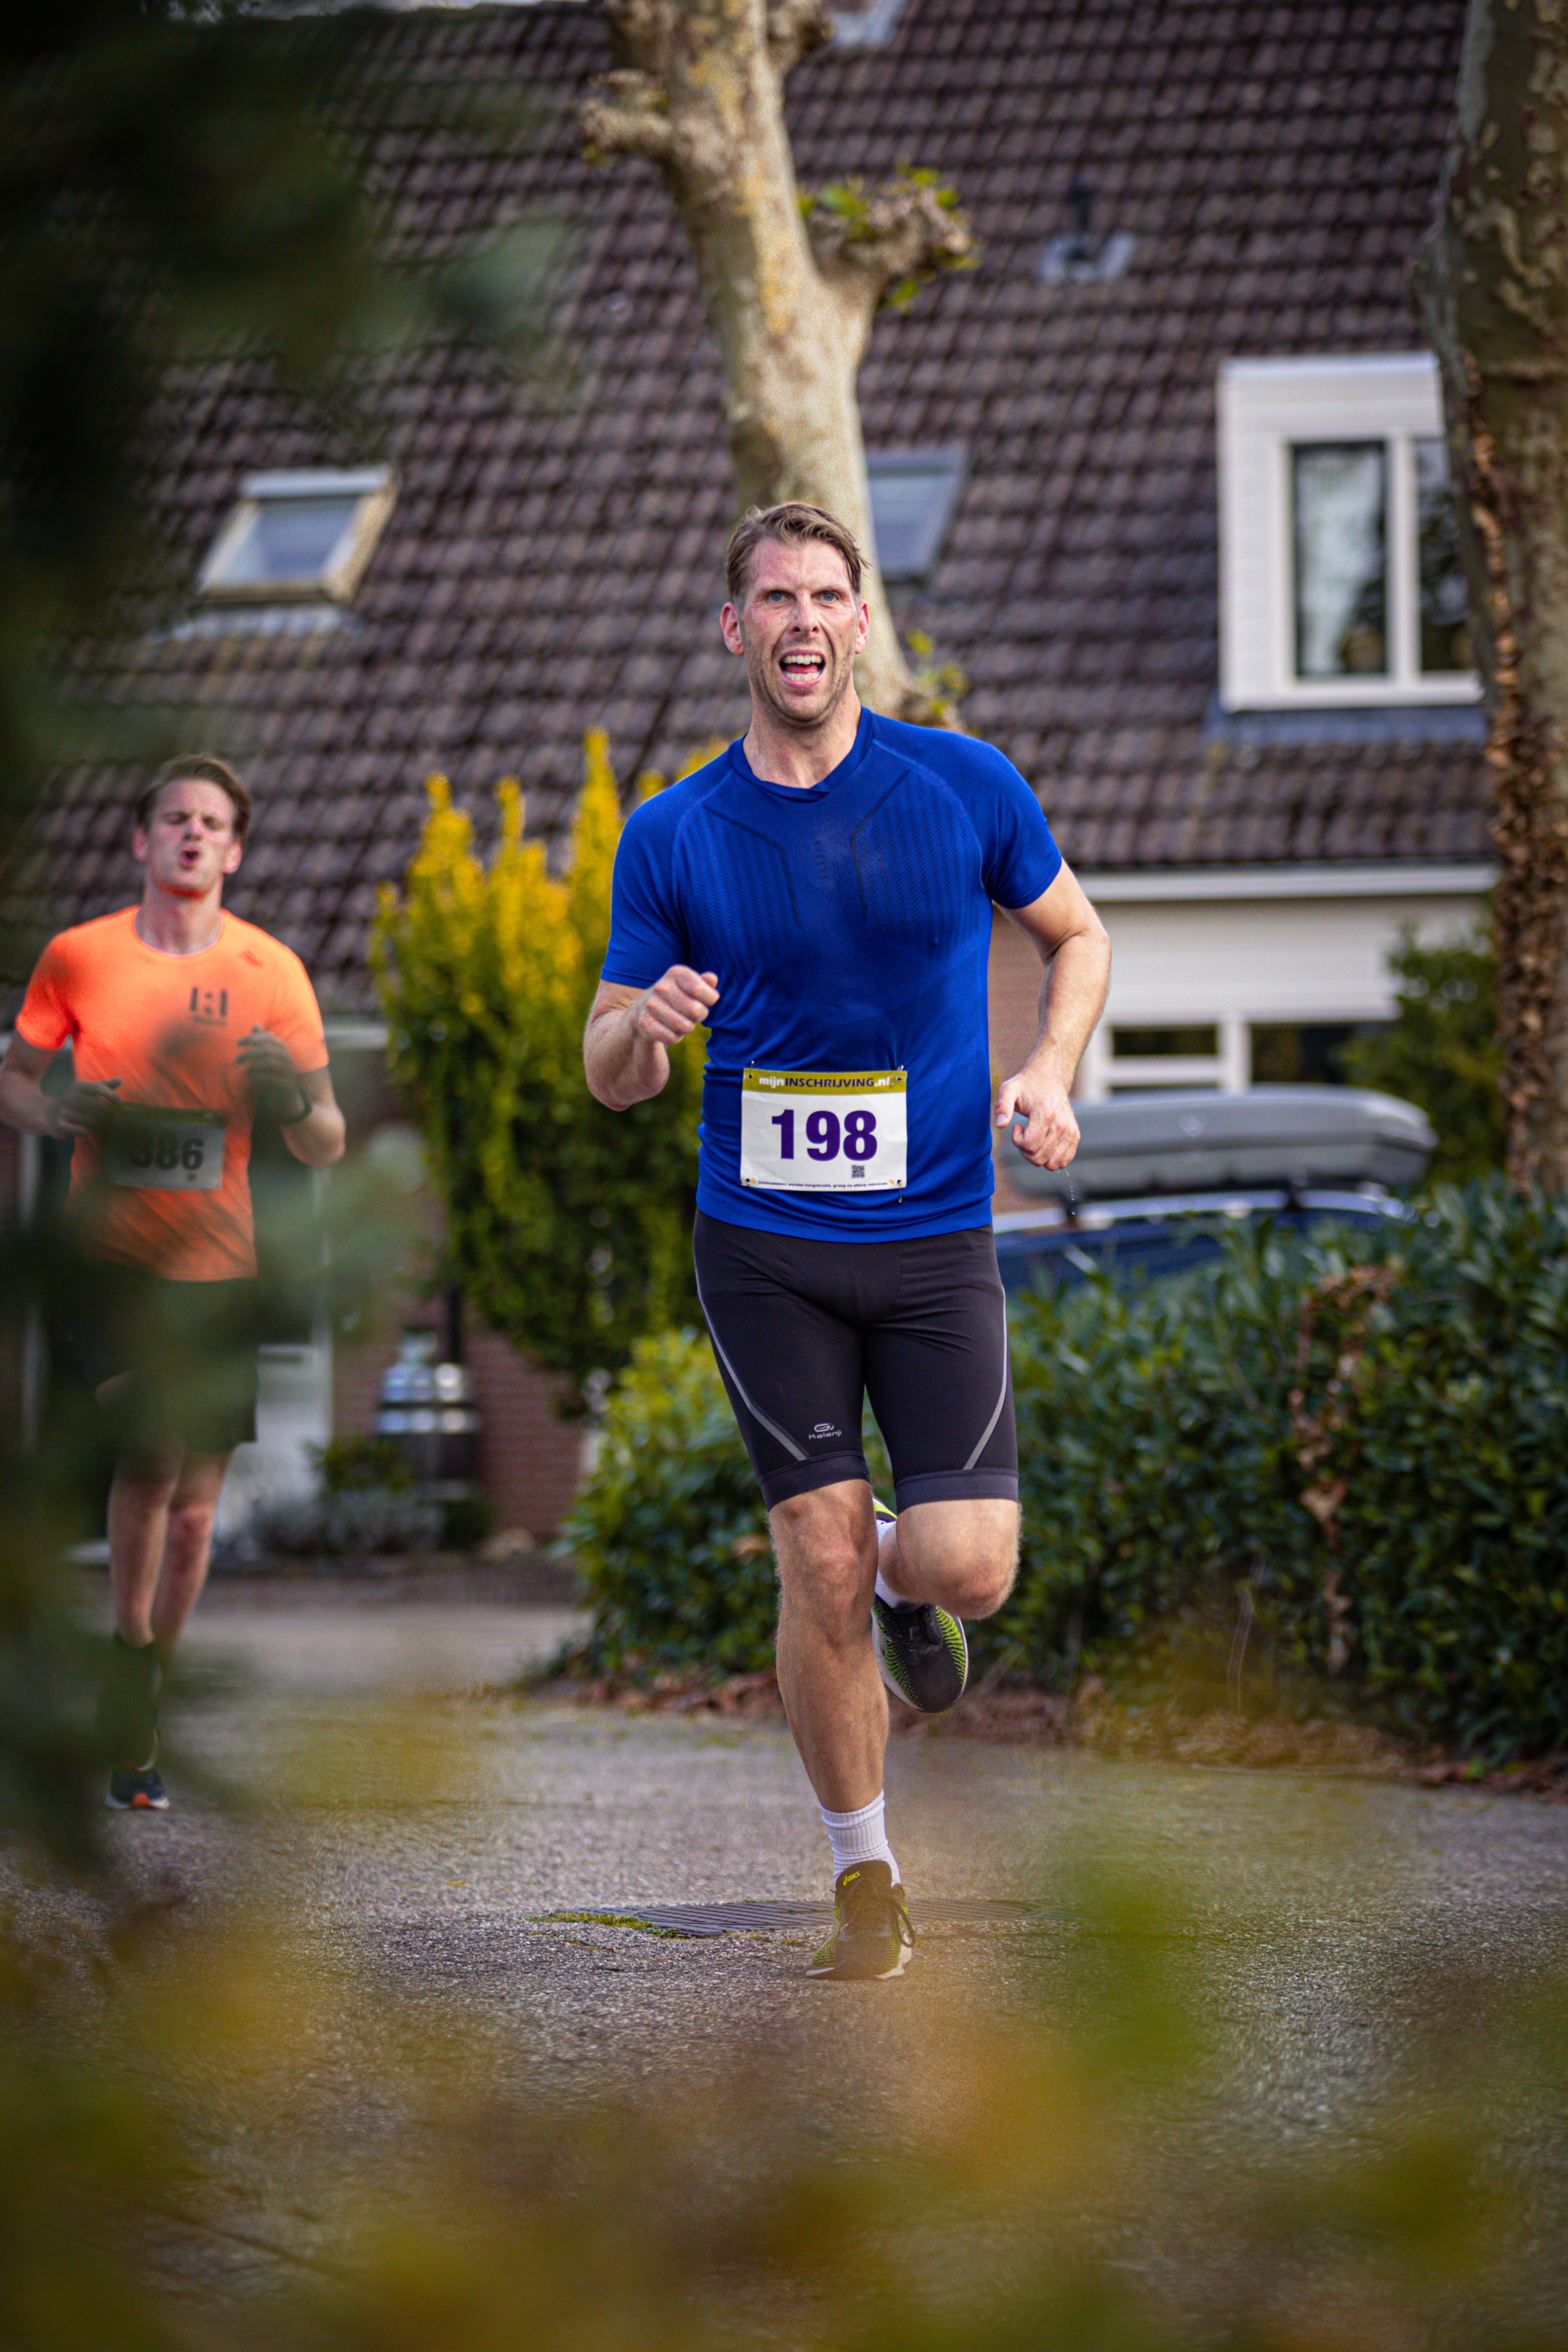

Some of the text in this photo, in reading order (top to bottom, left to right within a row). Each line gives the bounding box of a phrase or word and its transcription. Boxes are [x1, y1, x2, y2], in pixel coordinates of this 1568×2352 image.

[814, 840, 827, 881] KIPSTA
[771, 1109, 877, 1161] 198
[808, 1430, 842, 1440] Kalenji
[847, 1871, 860, 1882] asics
